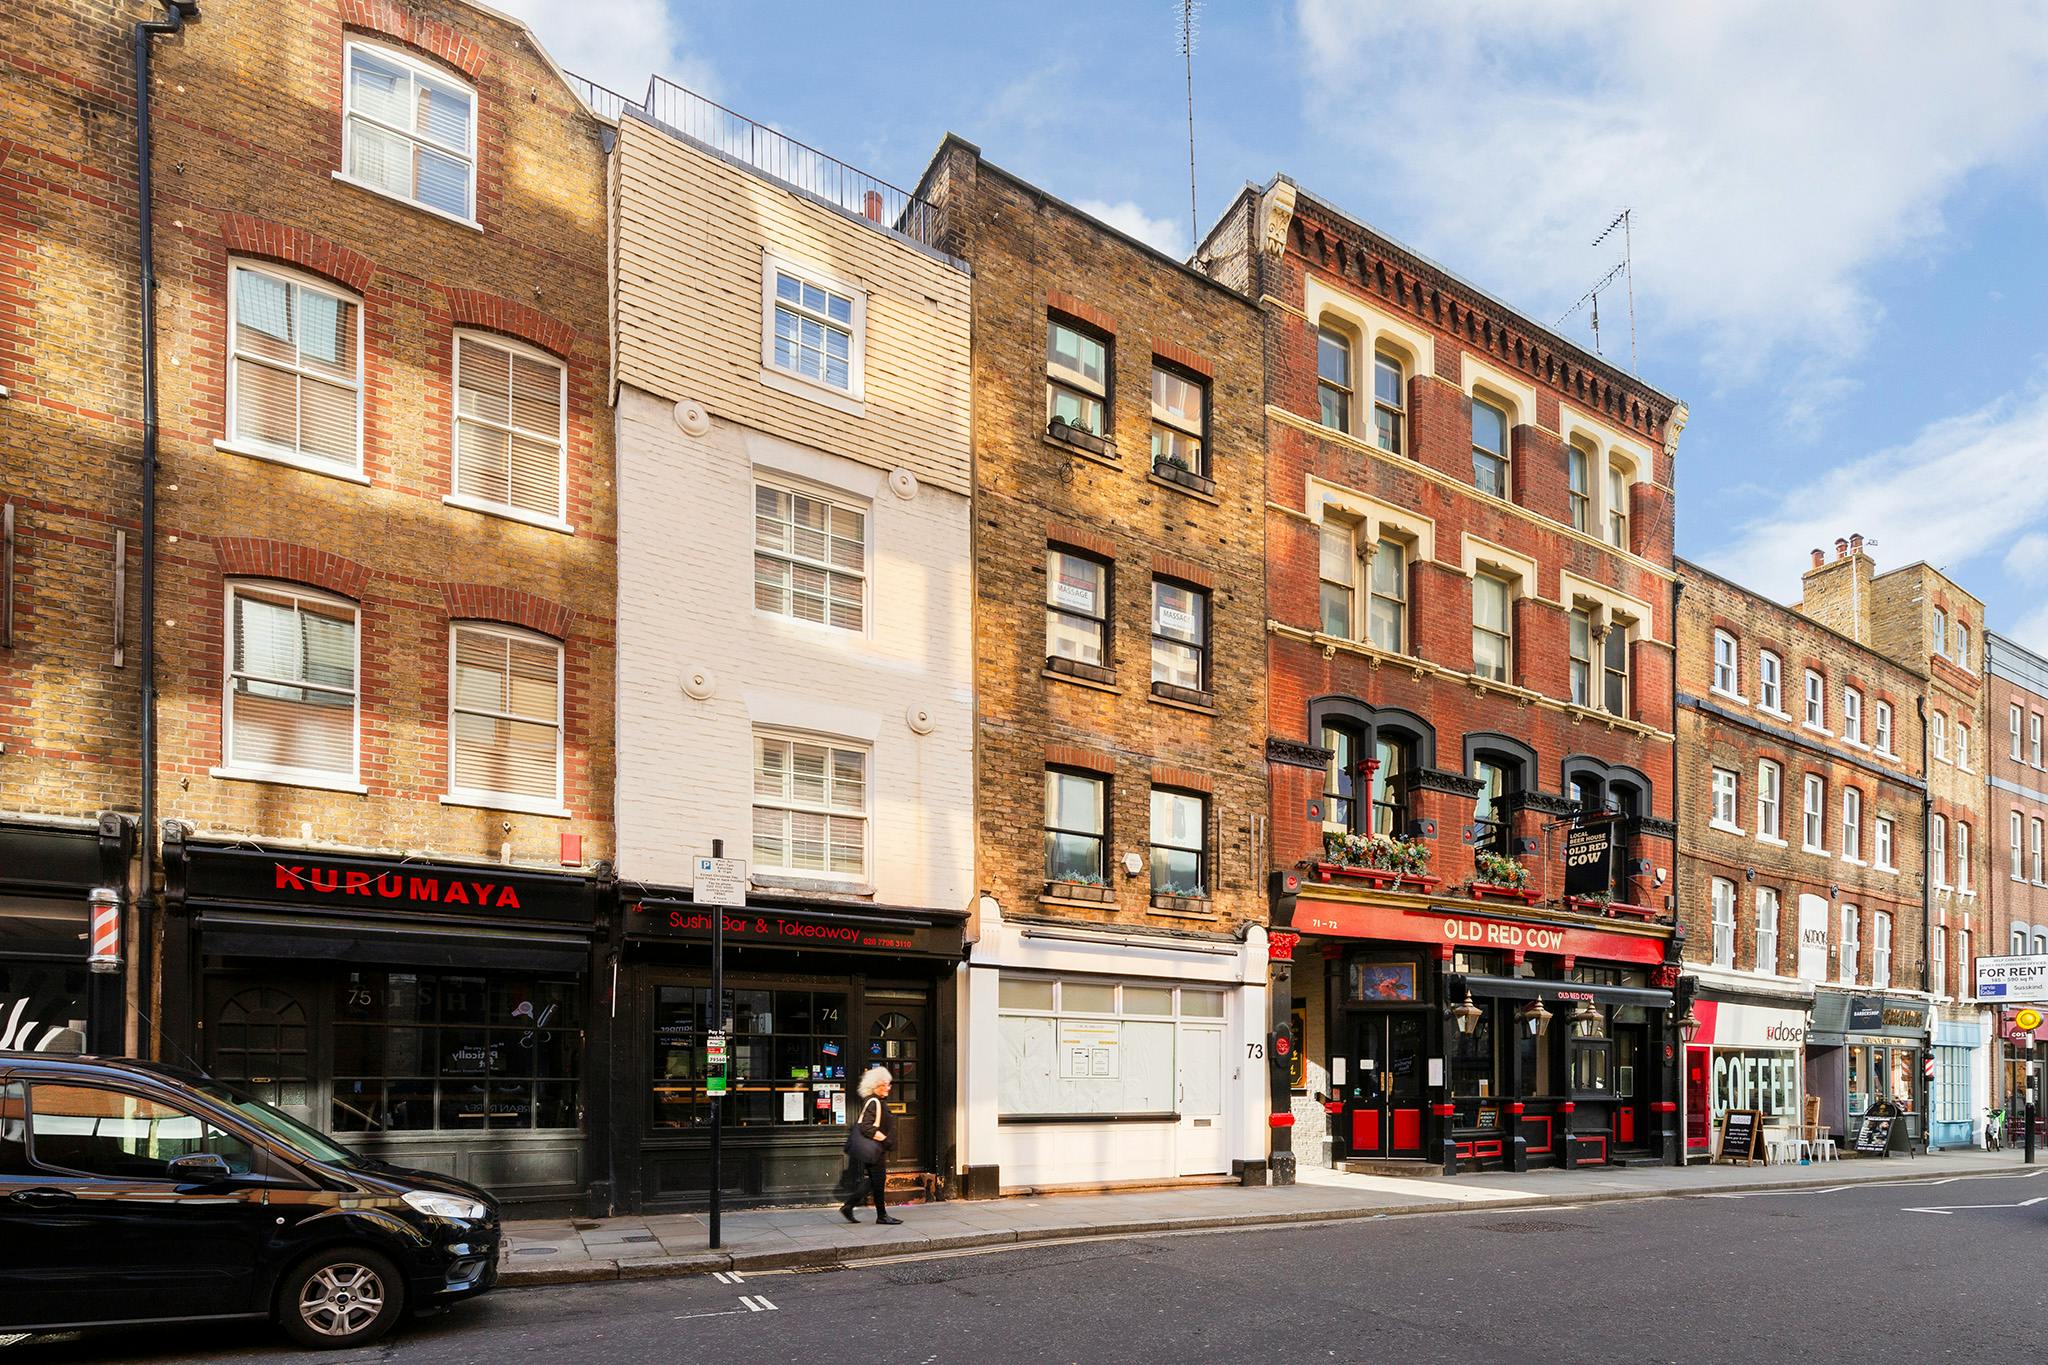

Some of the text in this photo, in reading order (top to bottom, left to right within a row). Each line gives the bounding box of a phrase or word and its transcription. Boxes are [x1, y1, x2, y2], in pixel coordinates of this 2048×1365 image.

[1058, 584, 1089, 599] MASSAGE
[1570, 831, 1588, 839] LOCAL
[1586, 833, 1606, 842] HOUSE
[1569, 842, 1608, 855] OLD RED
[1568, 851, 1601, 866] COW
[275, 865, 520, 909] KURUMAYA
[669, 911, 860, 943] Sushi Bar & Takeaway
[1312, 919, 1321, 928] 71
[1328, 920, 1338, 929] 72
[1444, 919, 1563, 950] OLD RED COW
[1979, 966, 2046, 978] FOR RENT
[349, 990, 371, 1005] 75
[1558, 991, 1594, 1001] OLD RED COW
[822, 1008, 838, 1020] 74
[1247, 1043, 1264, 1059] 73
[1713, 1056, 1795, 1118] COFFEE
